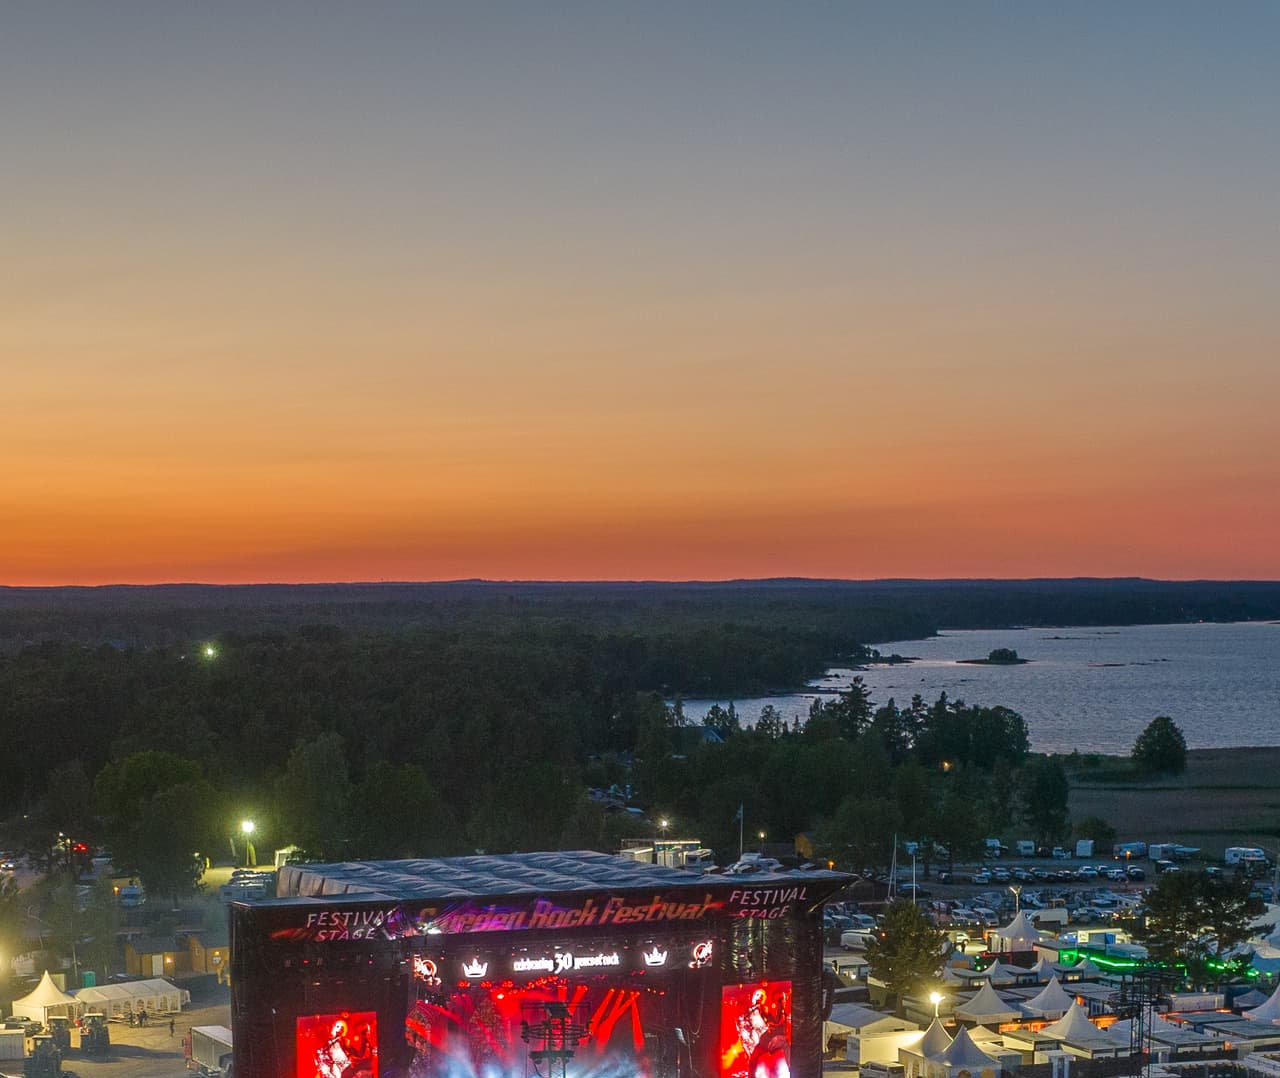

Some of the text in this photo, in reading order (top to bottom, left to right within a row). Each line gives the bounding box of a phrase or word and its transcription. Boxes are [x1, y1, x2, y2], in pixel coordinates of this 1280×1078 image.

[730, 887, 807, 905] FESTIVAL
[307, 908, 401, 929] FESTIVAL
[529, 897, 598, 928] Rock
[599, 893, 713, 925] Festival
[738, 905, 790, 919] STAGE
[316, 929, 376, 941] STAGE
[554, 953, 572, 974] 30
